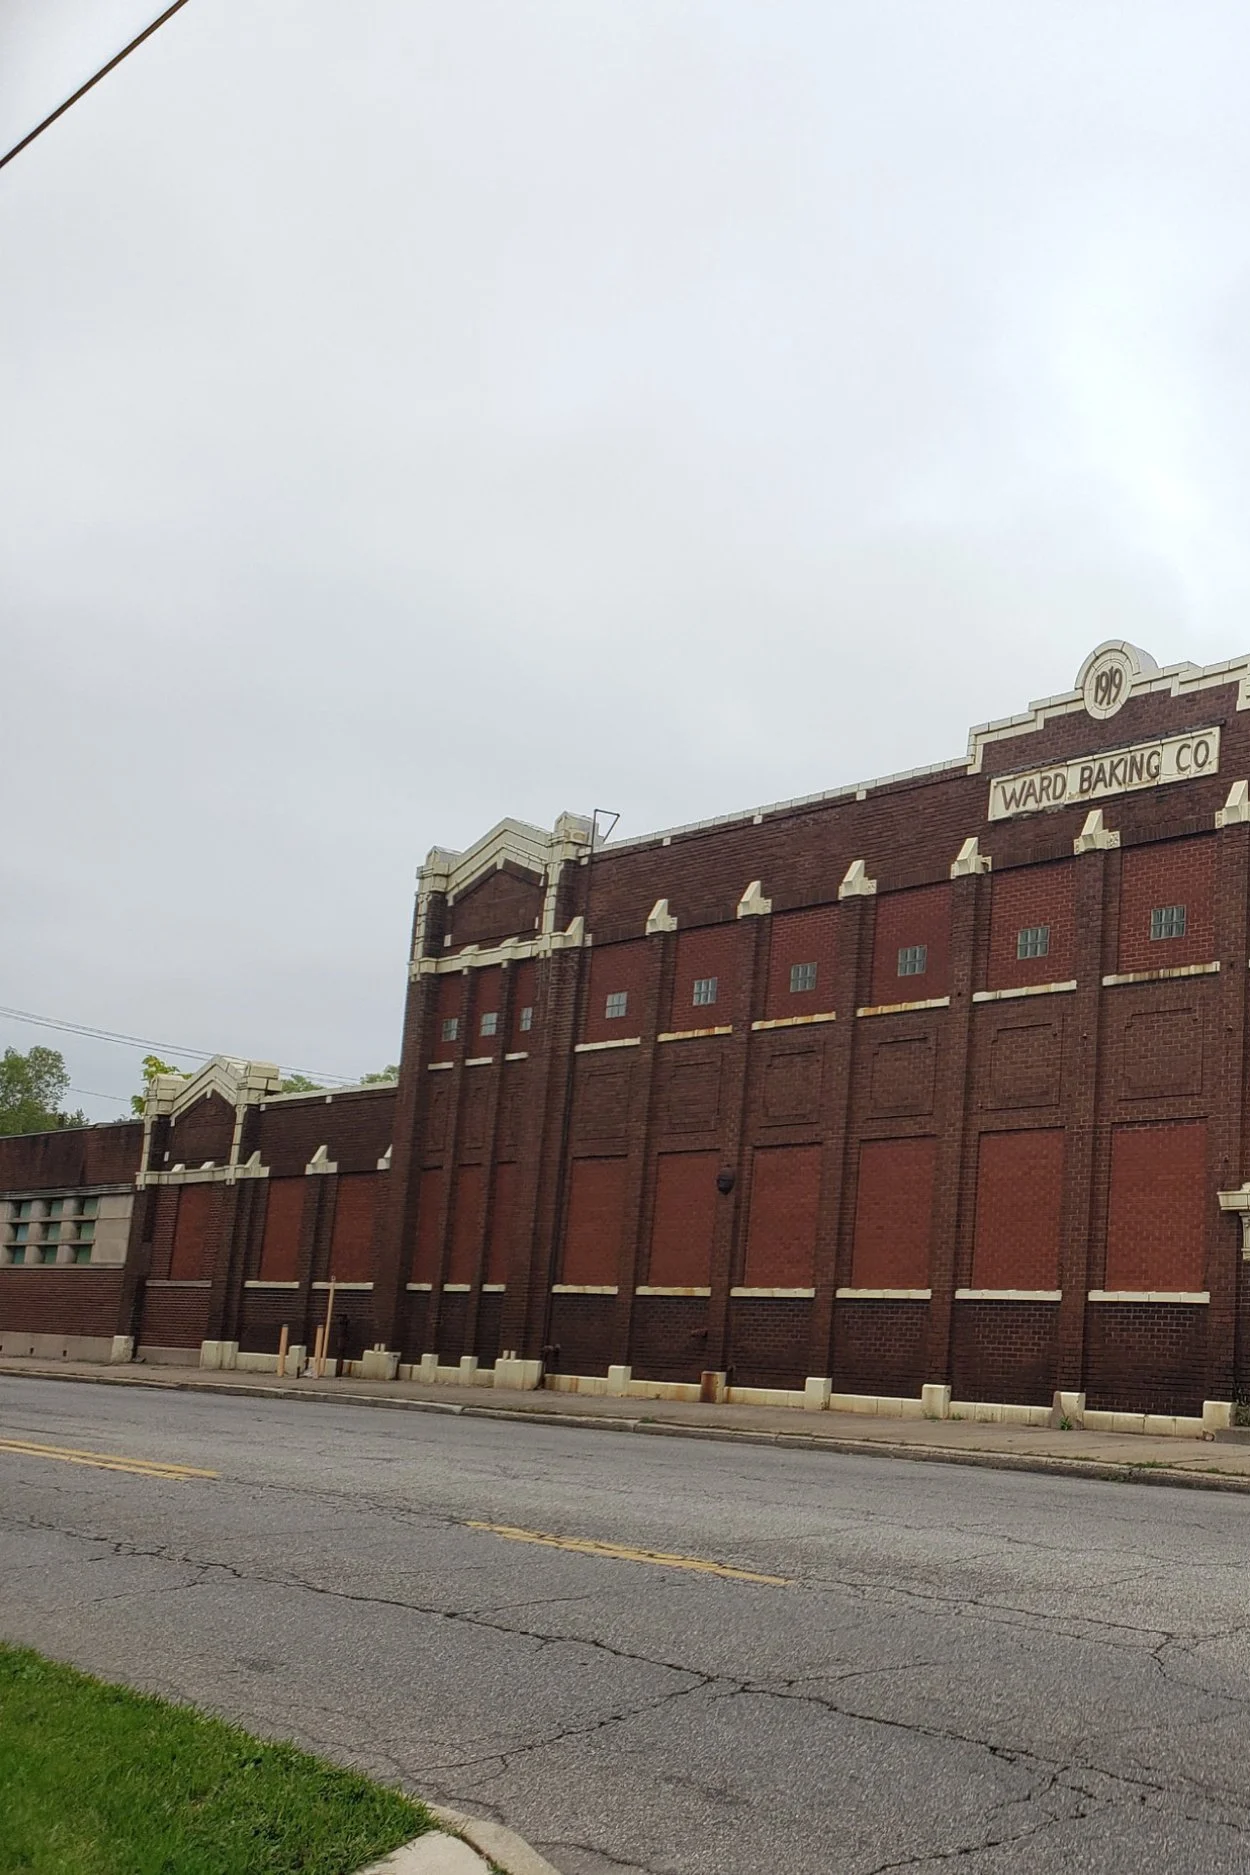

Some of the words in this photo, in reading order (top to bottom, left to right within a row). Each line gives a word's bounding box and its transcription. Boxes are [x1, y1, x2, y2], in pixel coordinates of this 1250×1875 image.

[1094, 666, 1123, 706] 1919
[1001, 772, 1067, 811] WARD
[1079, 750, 1161, 794] BAKING
